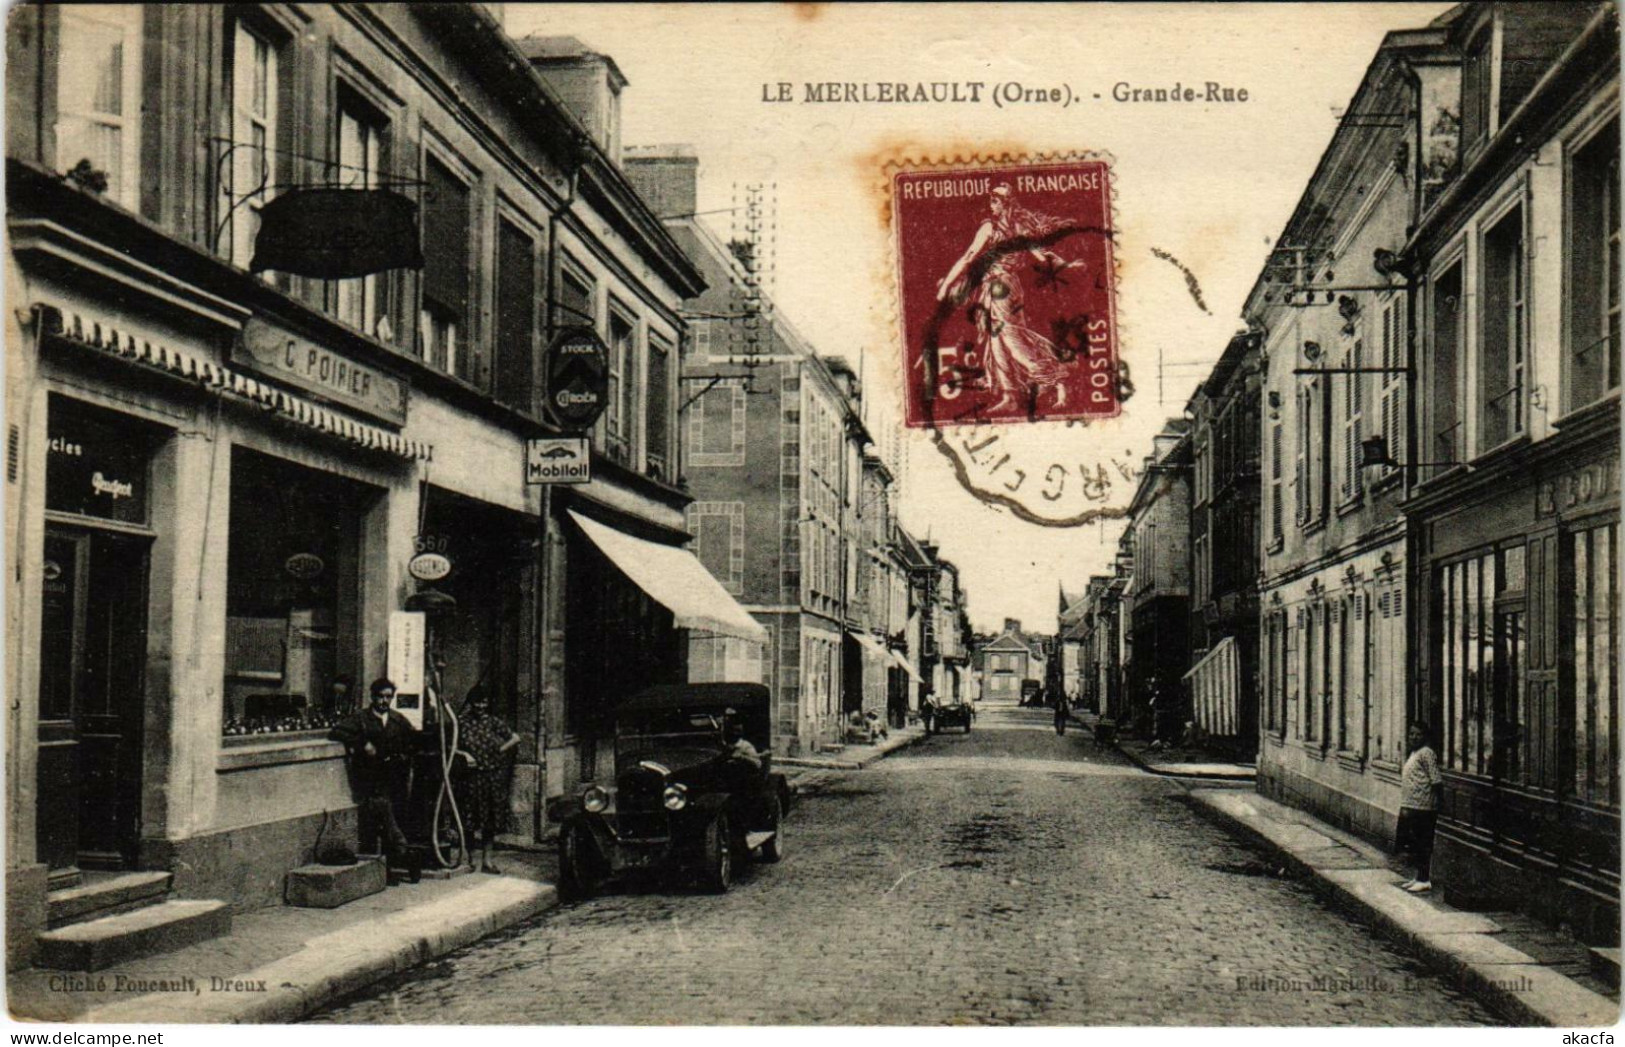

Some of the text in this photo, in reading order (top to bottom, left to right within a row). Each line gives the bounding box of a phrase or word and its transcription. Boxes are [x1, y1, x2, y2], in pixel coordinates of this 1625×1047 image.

[903, 172, 1099, 199] REPUBLIQUE FRANÇAISE
[560, 344, 594, 354] STOCK
[1091, 319, 1108, 402] POSTES
[306, 348, 372, 397] POIRIER
[529, 463, 588, 477] Mobiloil
